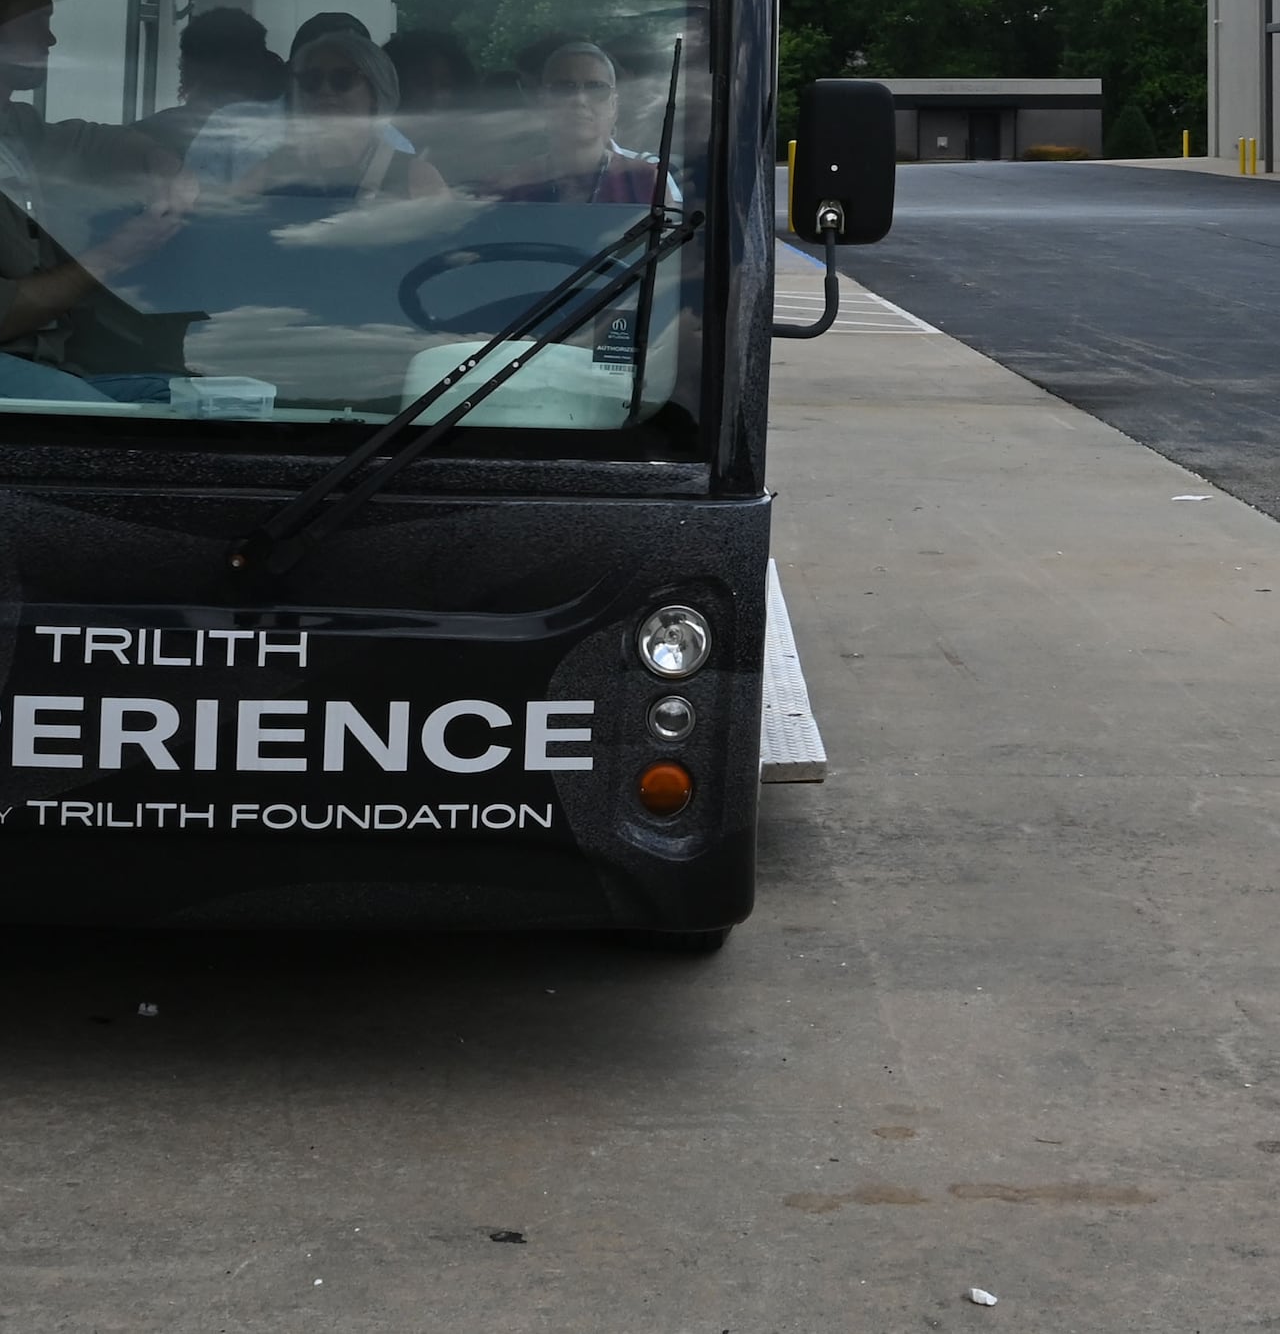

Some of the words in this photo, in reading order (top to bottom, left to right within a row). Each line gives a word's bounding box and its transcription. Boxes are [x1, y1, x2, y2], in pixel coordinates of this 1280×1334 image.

[35, 625, 308, 668] TRILITH
[26, 800, 215, 829] TRILITH
[231, 803, 553, 830] FOUNDATION
